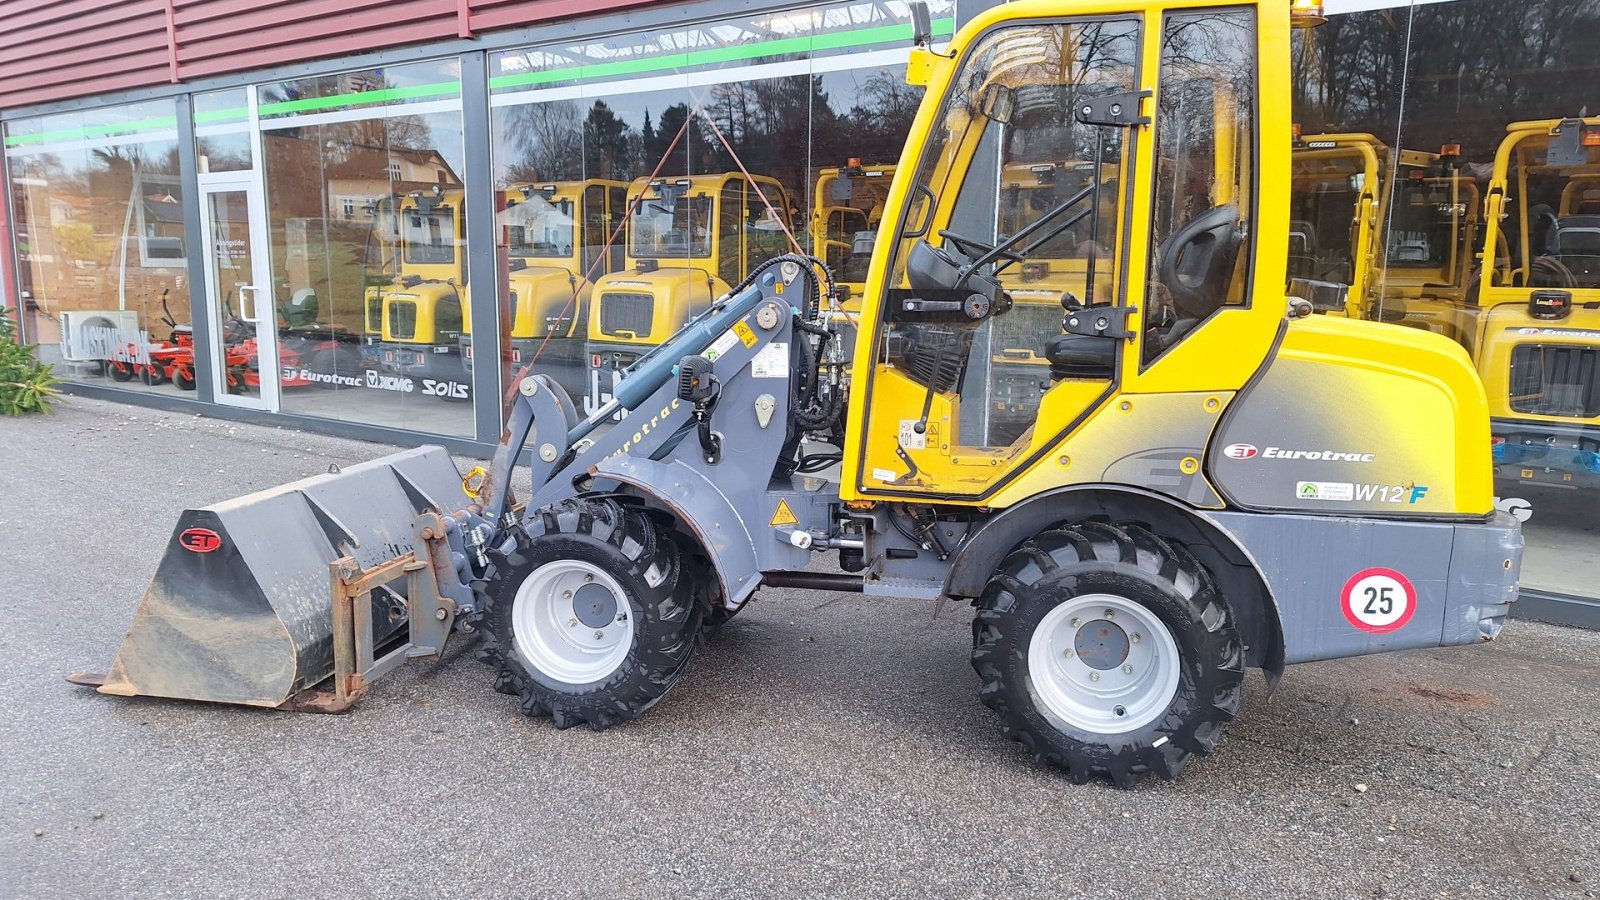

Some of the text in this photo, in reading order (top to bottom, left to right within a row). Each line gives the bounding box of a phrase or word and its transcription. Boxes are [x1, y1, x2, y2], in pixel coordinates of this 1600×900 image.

[300, 369, 362, 387] Eurotrac
[379, 376, 413, 392] XCMG
[422, 379, 469, 399] Solis
[602, 398, 679, 461] rotrac
[1224, 444, 1375, 462] ET Eurotrac
[180, 530, 220, 551] ET
[1363, 587, 1393, 614] 25
